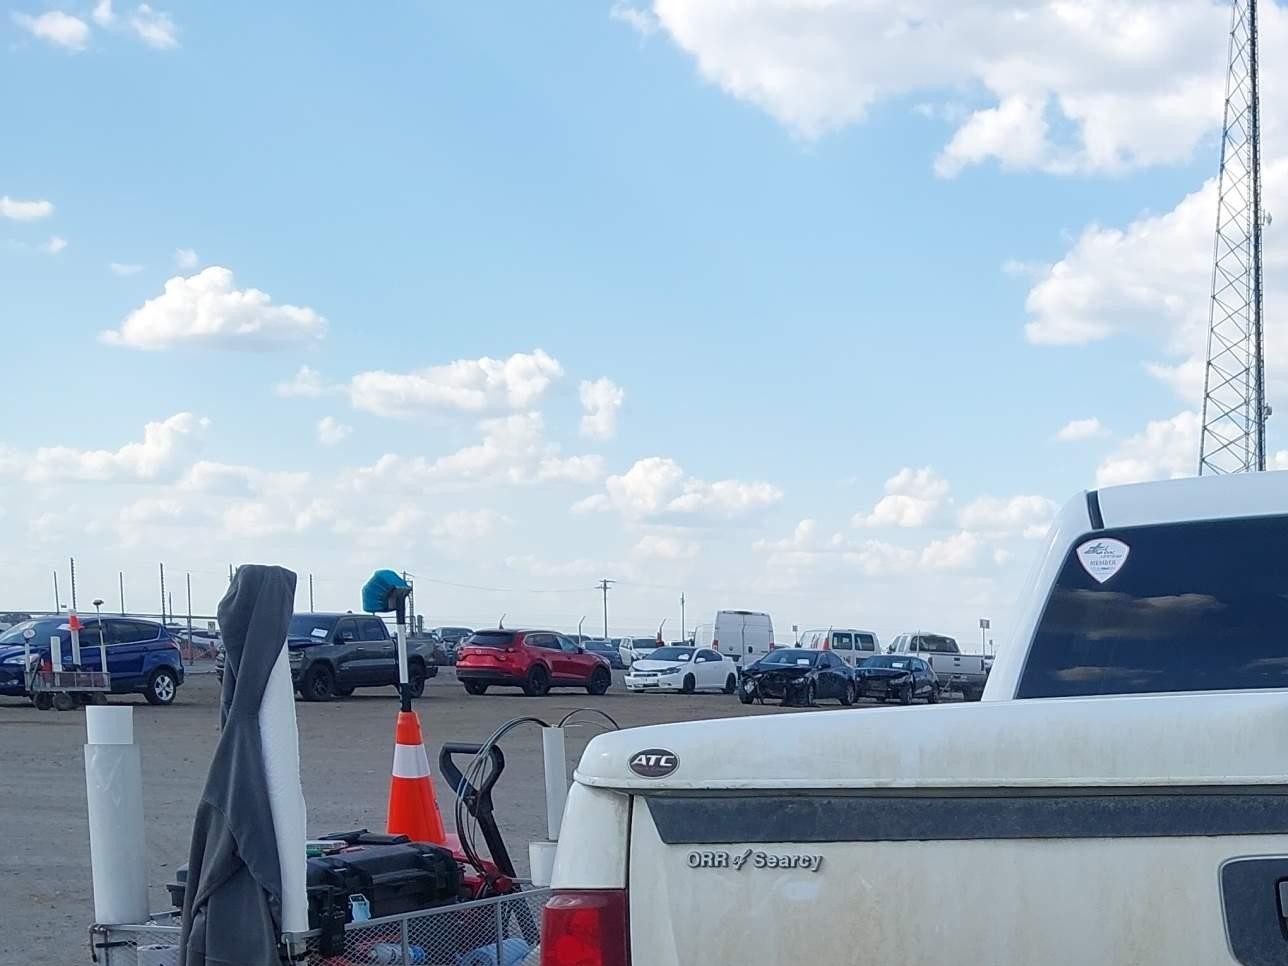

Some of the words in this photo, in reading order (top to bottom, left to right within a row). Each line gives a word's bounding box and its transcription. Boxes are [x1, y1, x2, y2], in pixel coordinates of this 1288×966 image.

[631, 754, 675, 767] ATC
[687, 851, 729, 868] ORR
[754, 851, 823, 872] Searcy
